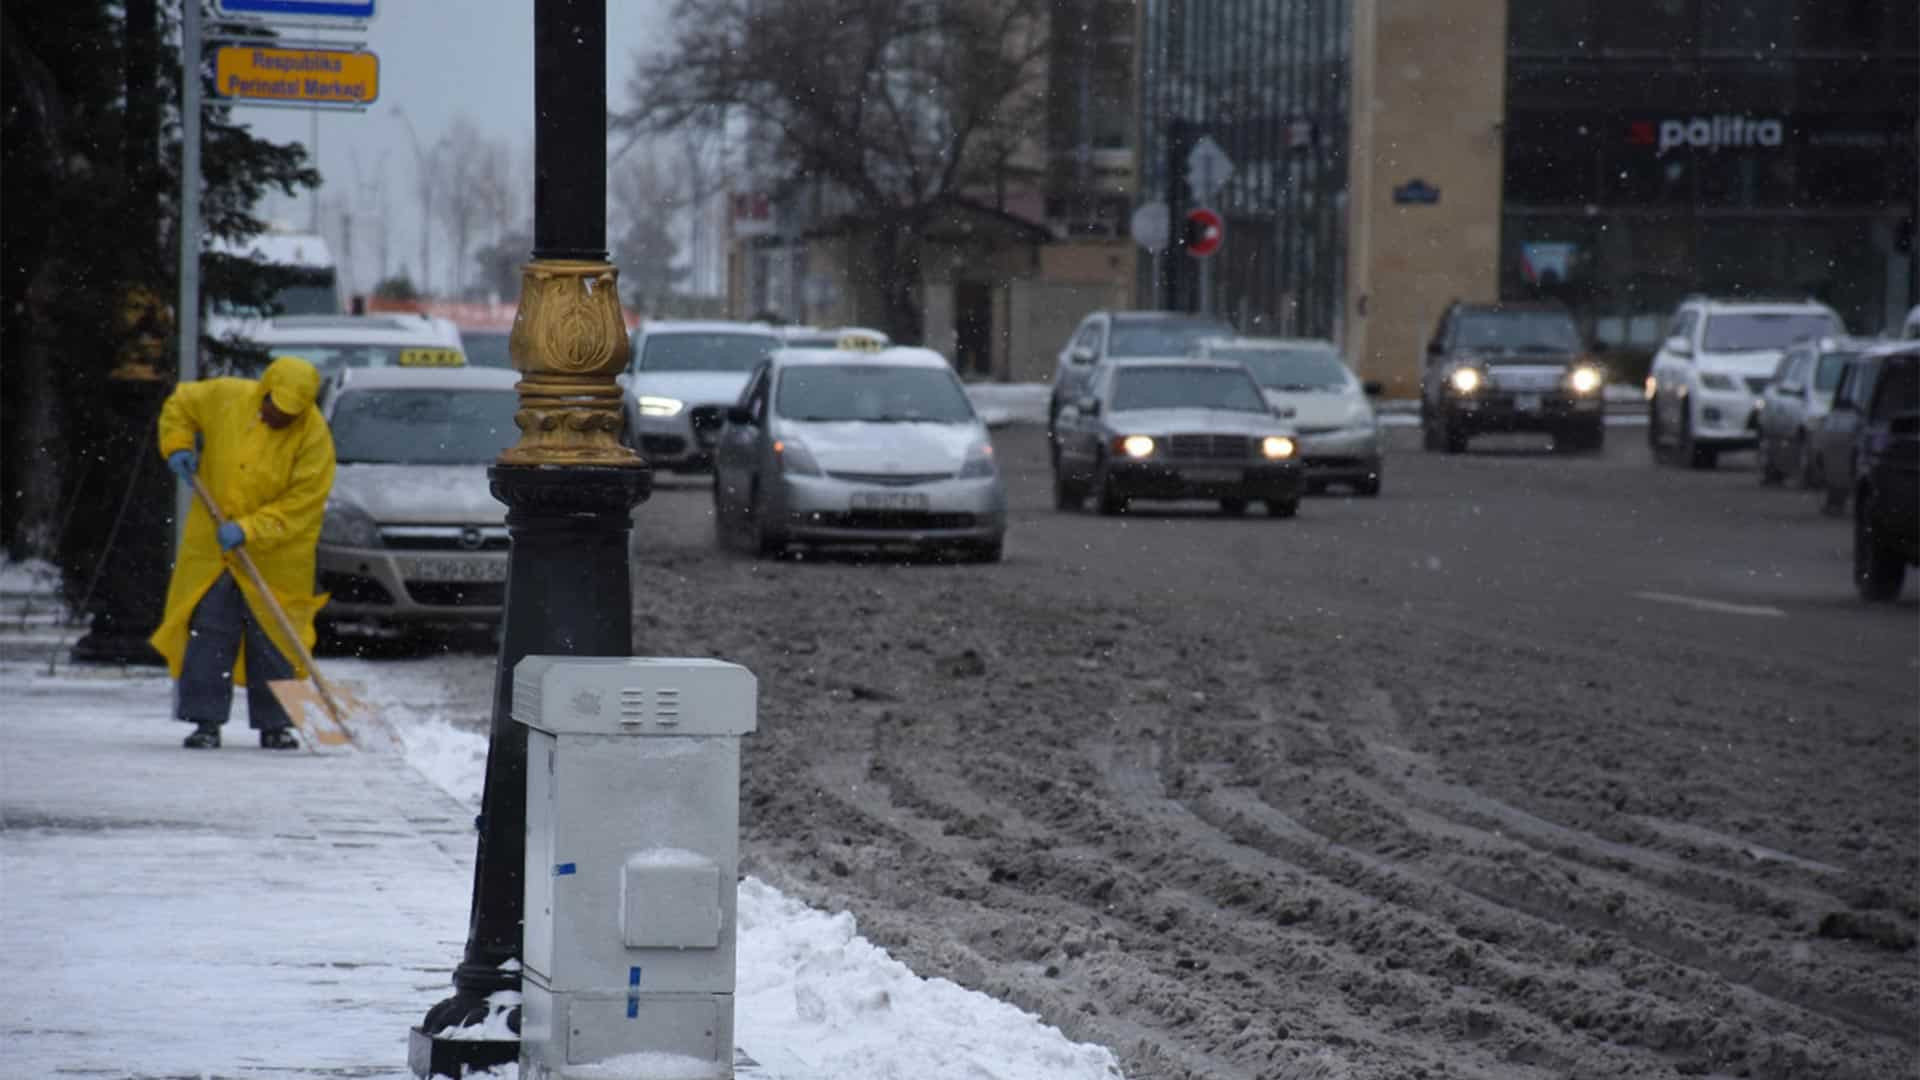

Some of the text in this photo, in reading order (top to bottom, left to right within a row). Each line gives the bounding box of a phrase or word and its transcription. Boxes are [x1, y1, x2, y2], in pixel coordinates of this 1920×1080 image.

[252, 52, 343, 72] Respublika
[228, 74, 299, 95] Perinatal
[1659, 115, 1783, 150] palitra
